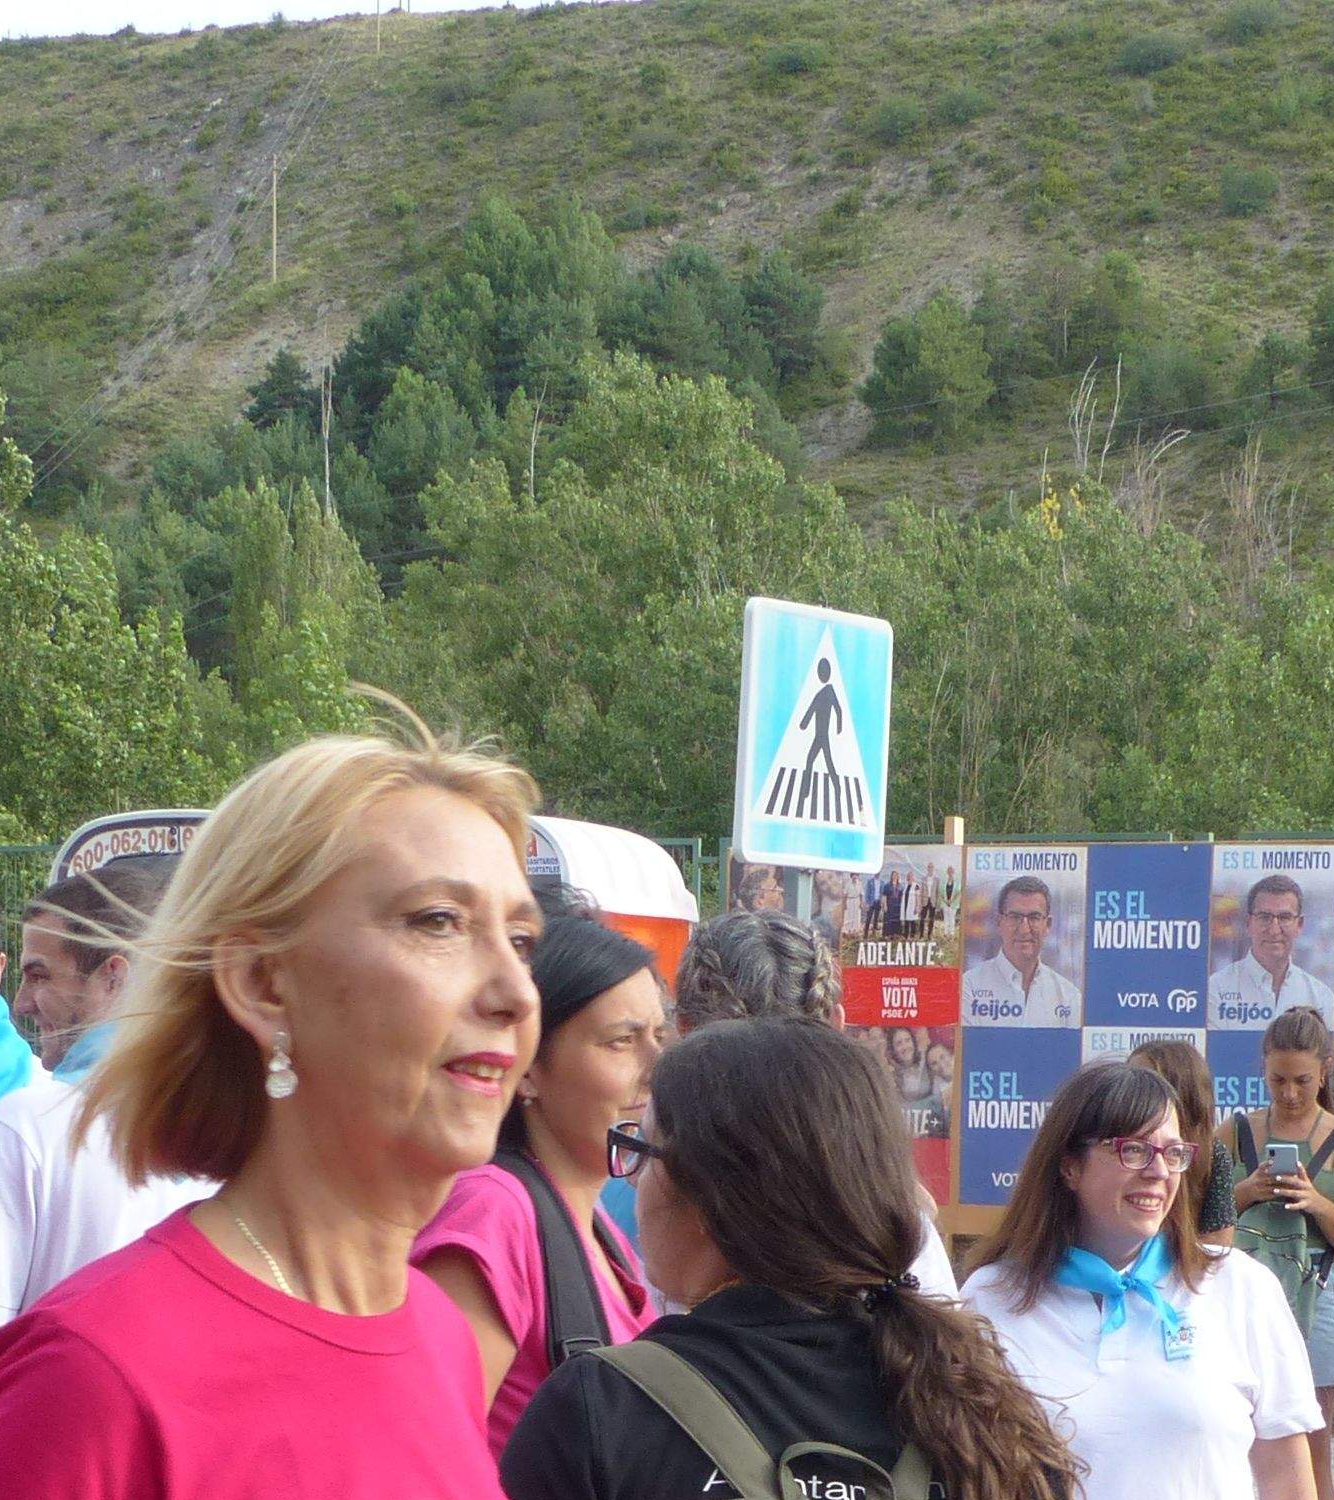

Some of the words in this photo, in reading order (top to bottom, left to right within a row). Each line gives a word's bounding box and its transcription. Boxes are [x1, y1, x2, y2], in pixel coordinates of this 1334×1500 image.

[975, 853, 990, 871] ES
[993, 853, 1009, 871] EL
[1012, 853, 1077, 871] MOMENTO
[1222, 852, 1238, 869] ES
[1243, 852, 1258, 869] EL
[1261, 852, 1330, 869] MOMENTO
[1094, 890, 1120, 919] ES
[1126, 891, 1151, 919] EL
[1094, 920, 1201, 949] MOMENTO
[856, 941, 936, 966] ADELANTE
[882, 987, 917, 1007] VOTA
[971, 990, 994, 998] VOTA
[1117, 993, 1159, 1008] VOTA
[1218, 992, 1242, 1000] VOTA
[971, 999, 1022, 1020] feijóo
[1218, 1002, 1272, 1024] feijóo
[1091, 1033, 1107, 1050] ES
[1111, 1033, 1126, 1050] EL
[969, 1071, 994, 1100] ES
[999, 1072, 1024, 1100] EL
[1214, 1076, 1240, 1105] ES
[1245, 1077, 1271, 1105] EL
[968, 1100, 1053, 1129] MOMEN
